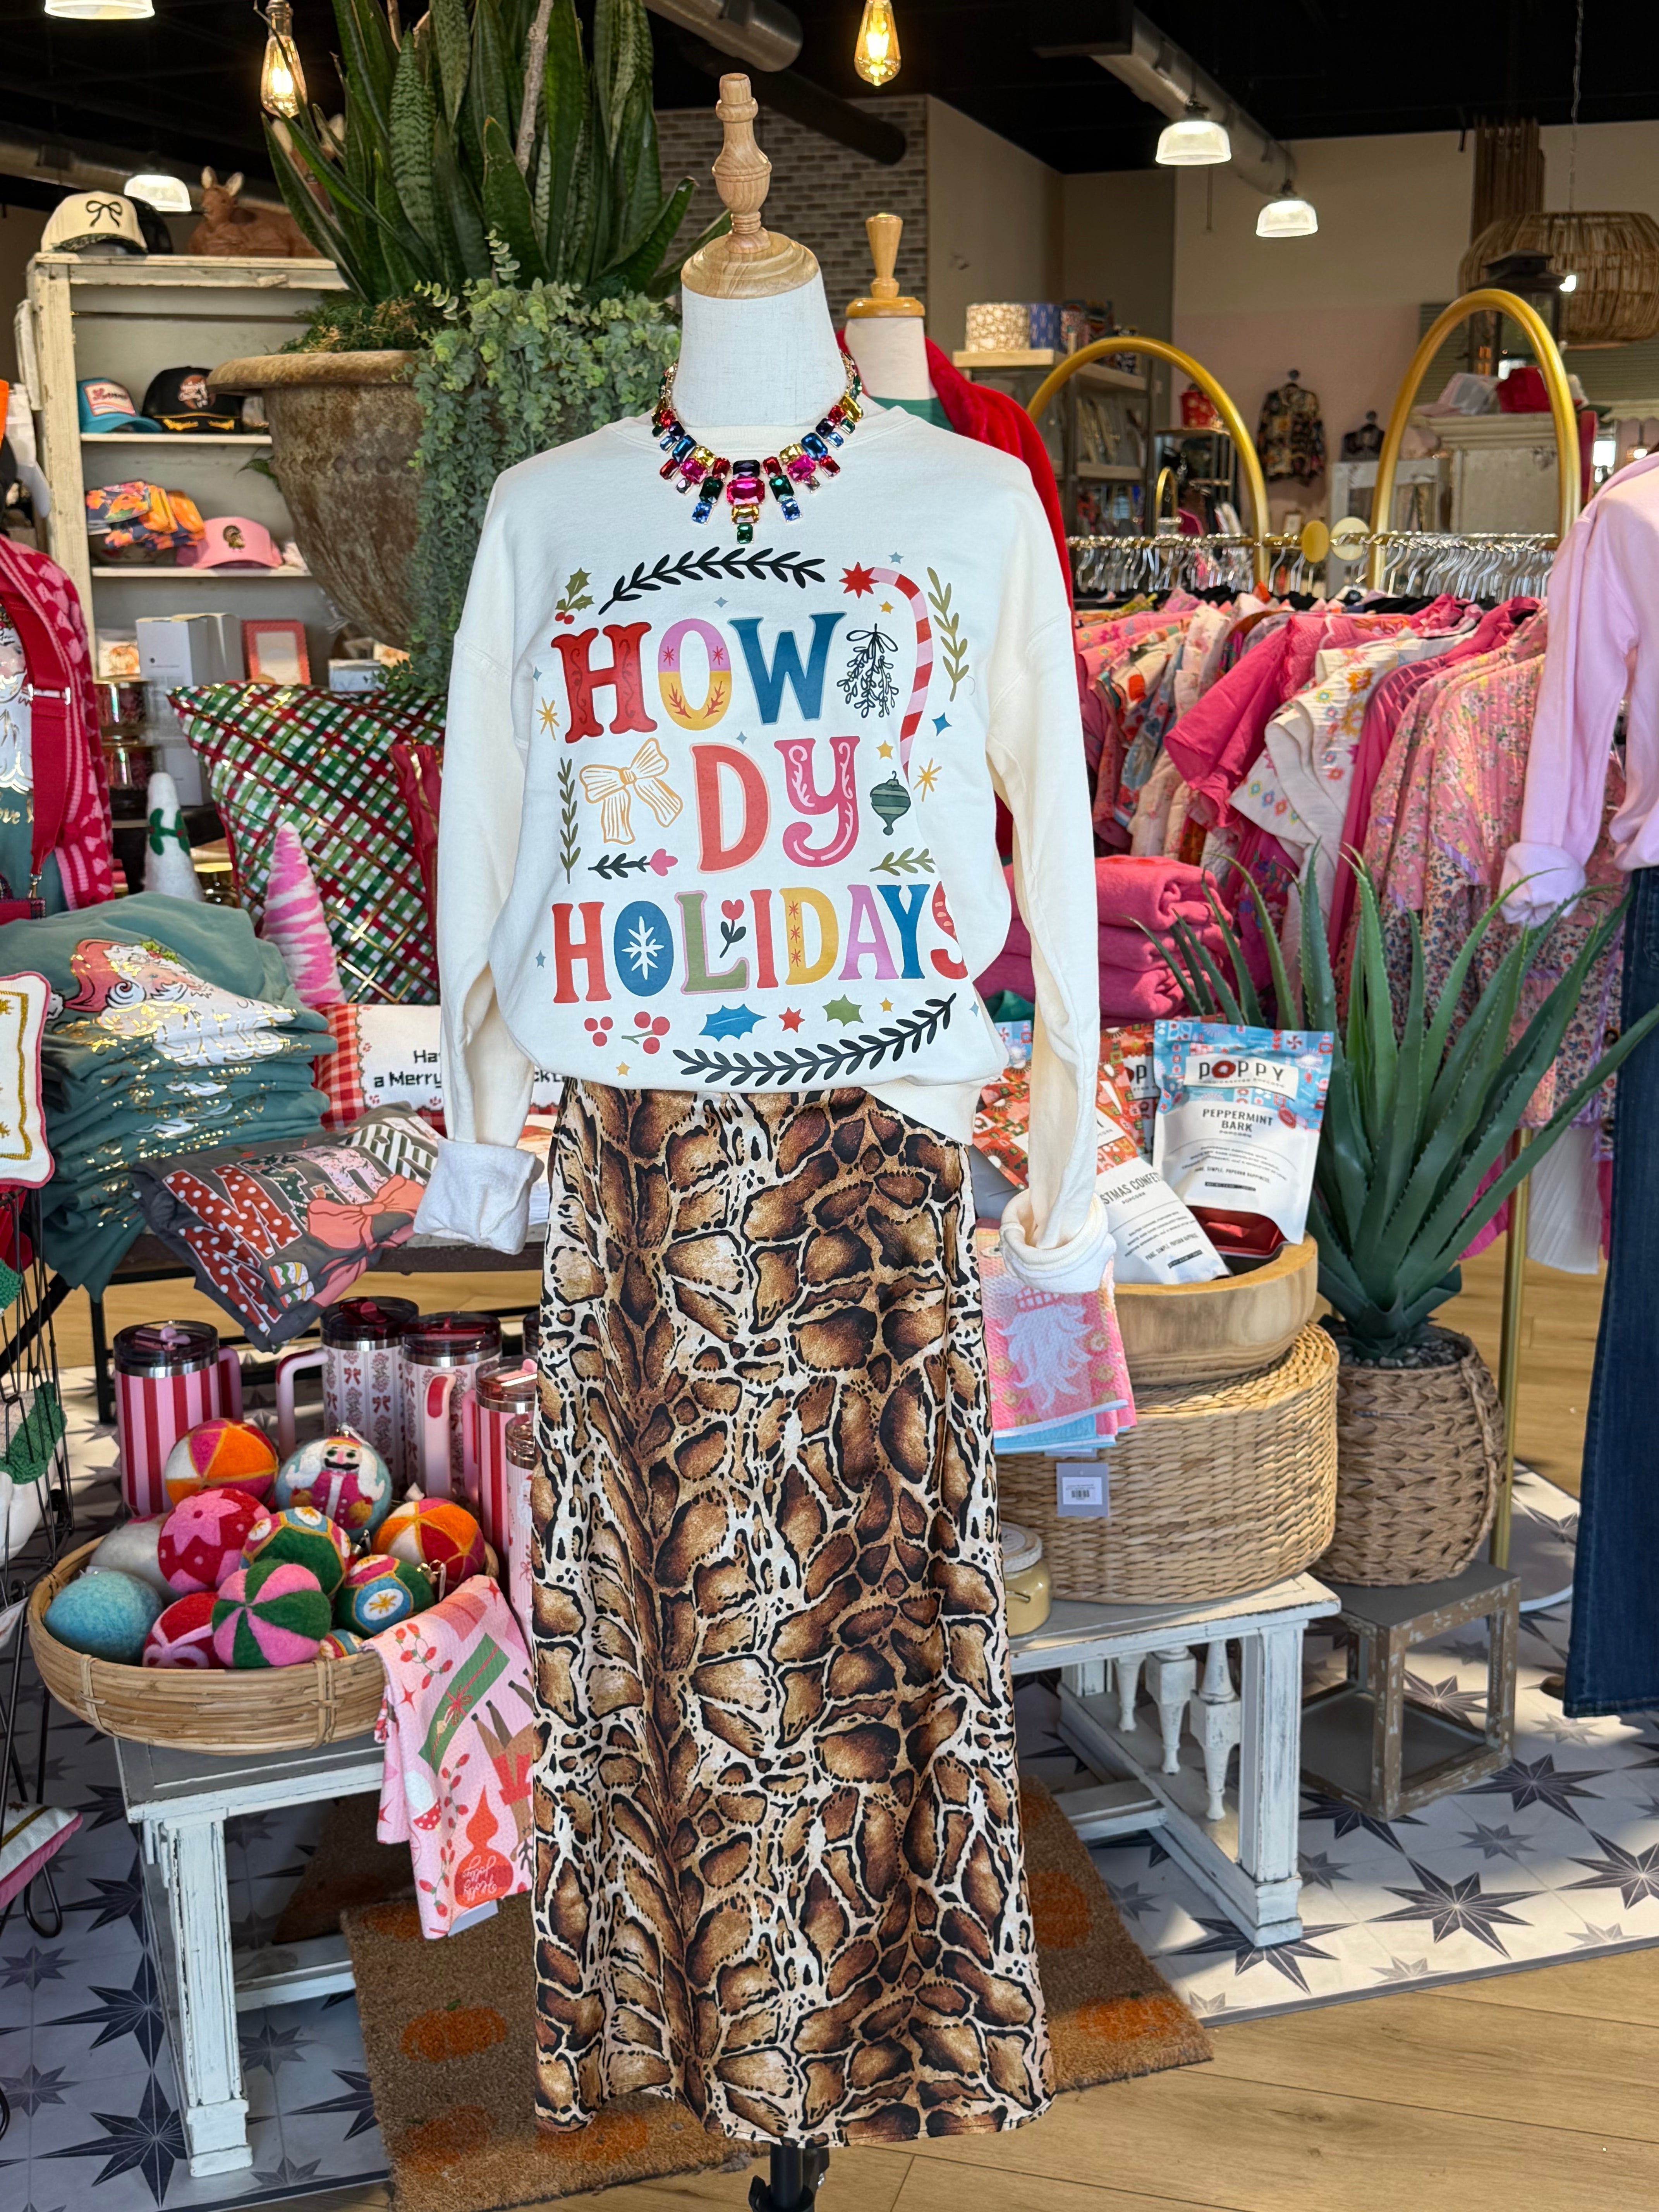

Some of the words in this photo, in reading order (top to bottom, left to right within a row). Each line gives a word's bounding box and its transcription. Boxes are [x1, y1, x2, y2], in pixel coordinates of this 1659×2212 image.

[551, 612, 846, 743] HOW
[691, 736, 859, 874] DY
[552, 881, 969, 1003] HOLIDAYS
[414, 1049, 441, 1064] Ha
[374, 1076, 385, 1088] a
[1202, 1108, 1273, 1127] PEPPERMINT
[1221, 1120, 1252, 1133] BARK
[1099, 1183, 1132, 1205] STMAS
